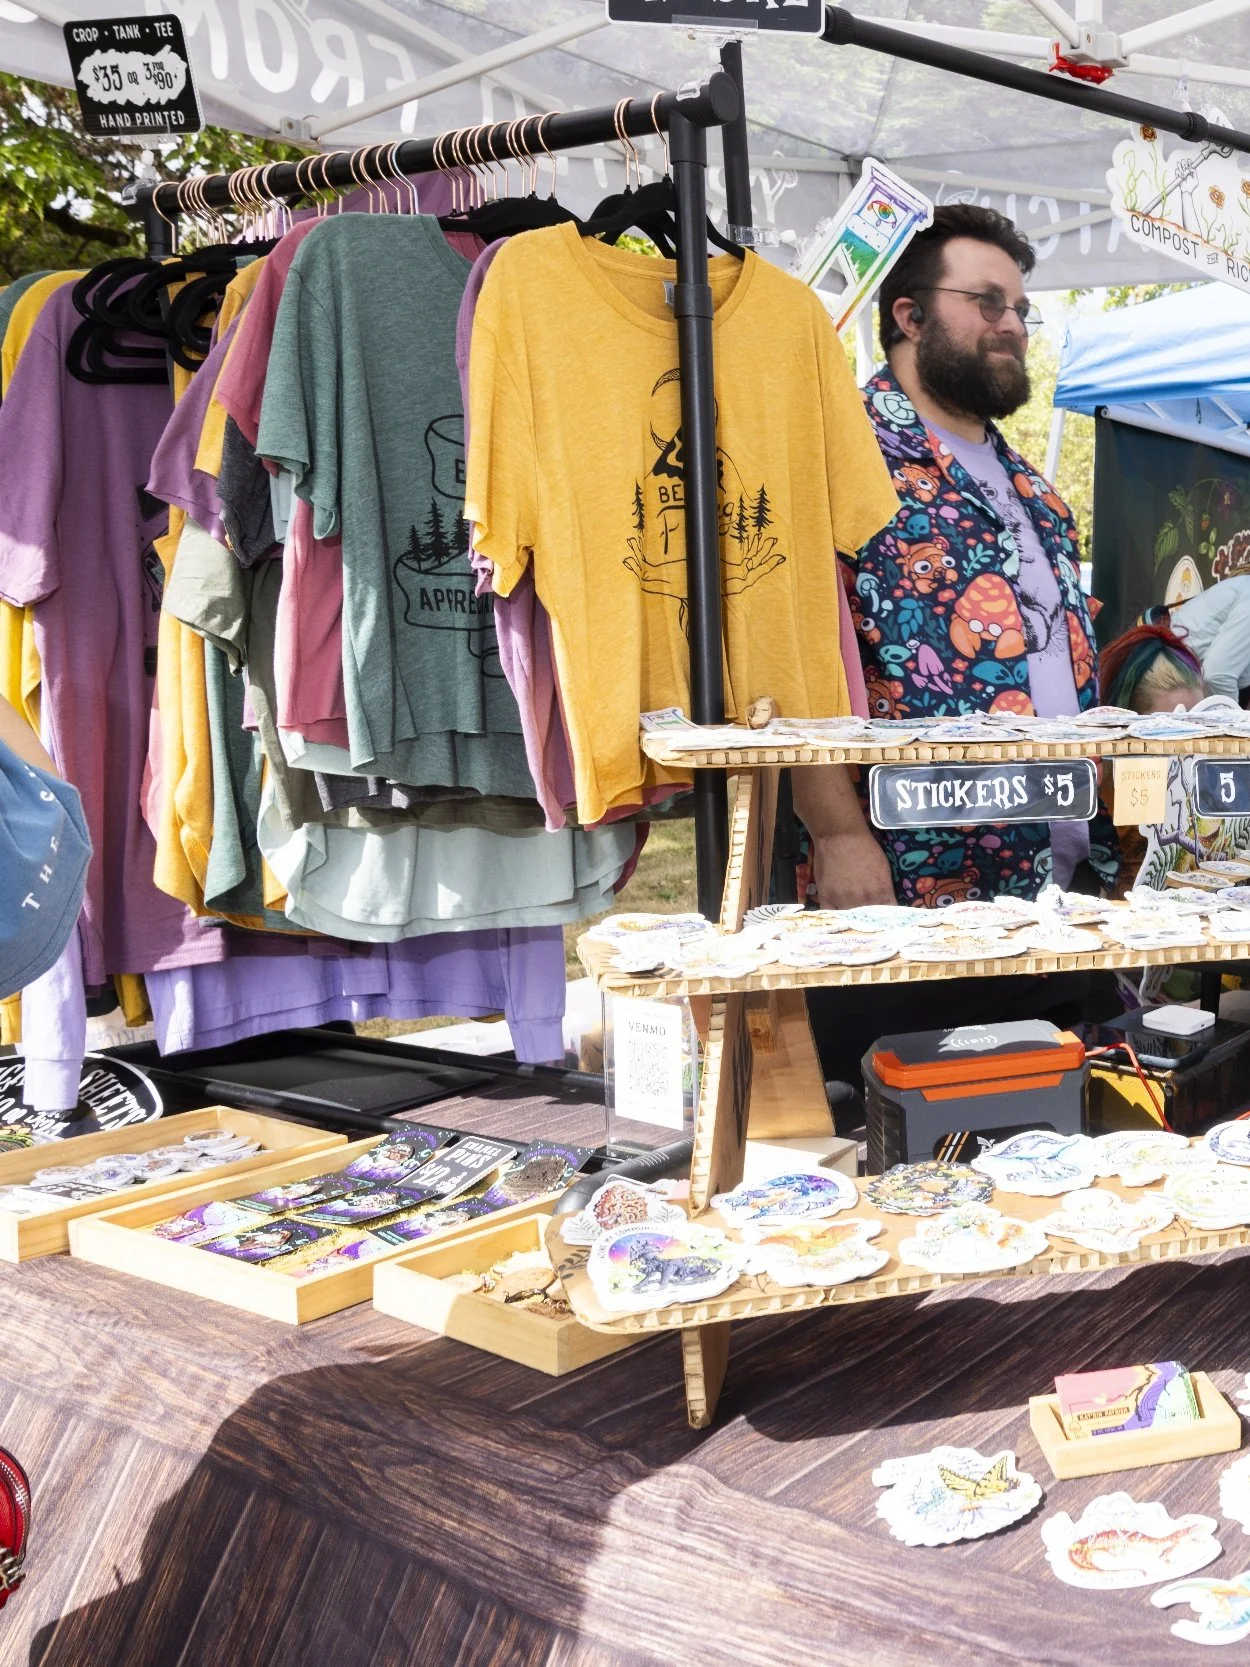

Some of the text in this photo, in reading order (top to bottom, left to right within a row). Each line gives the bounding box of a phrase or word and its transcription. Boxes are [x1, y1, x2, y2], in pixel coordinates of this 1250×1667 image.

[72, 22, 174, 43] CROP TANK TEE
[92, 63, 139, 92] $35 OR
[143, 61, 166, 81] 3 FOR
[99, 110, 185, 128] HAND PRINTED
[1130, 214, 1200, 259] COMPOST
[1121, 769, 1161, 780] STICKERS
[895, 771, 1075, 812] STICKERS $5
[1130, 787, 1149, 807] $5
[1219, 770, 1236, 803] 5
[628, 1020, 667, 1037] VENMO
[444, 1148, 493, 1169] PINS
